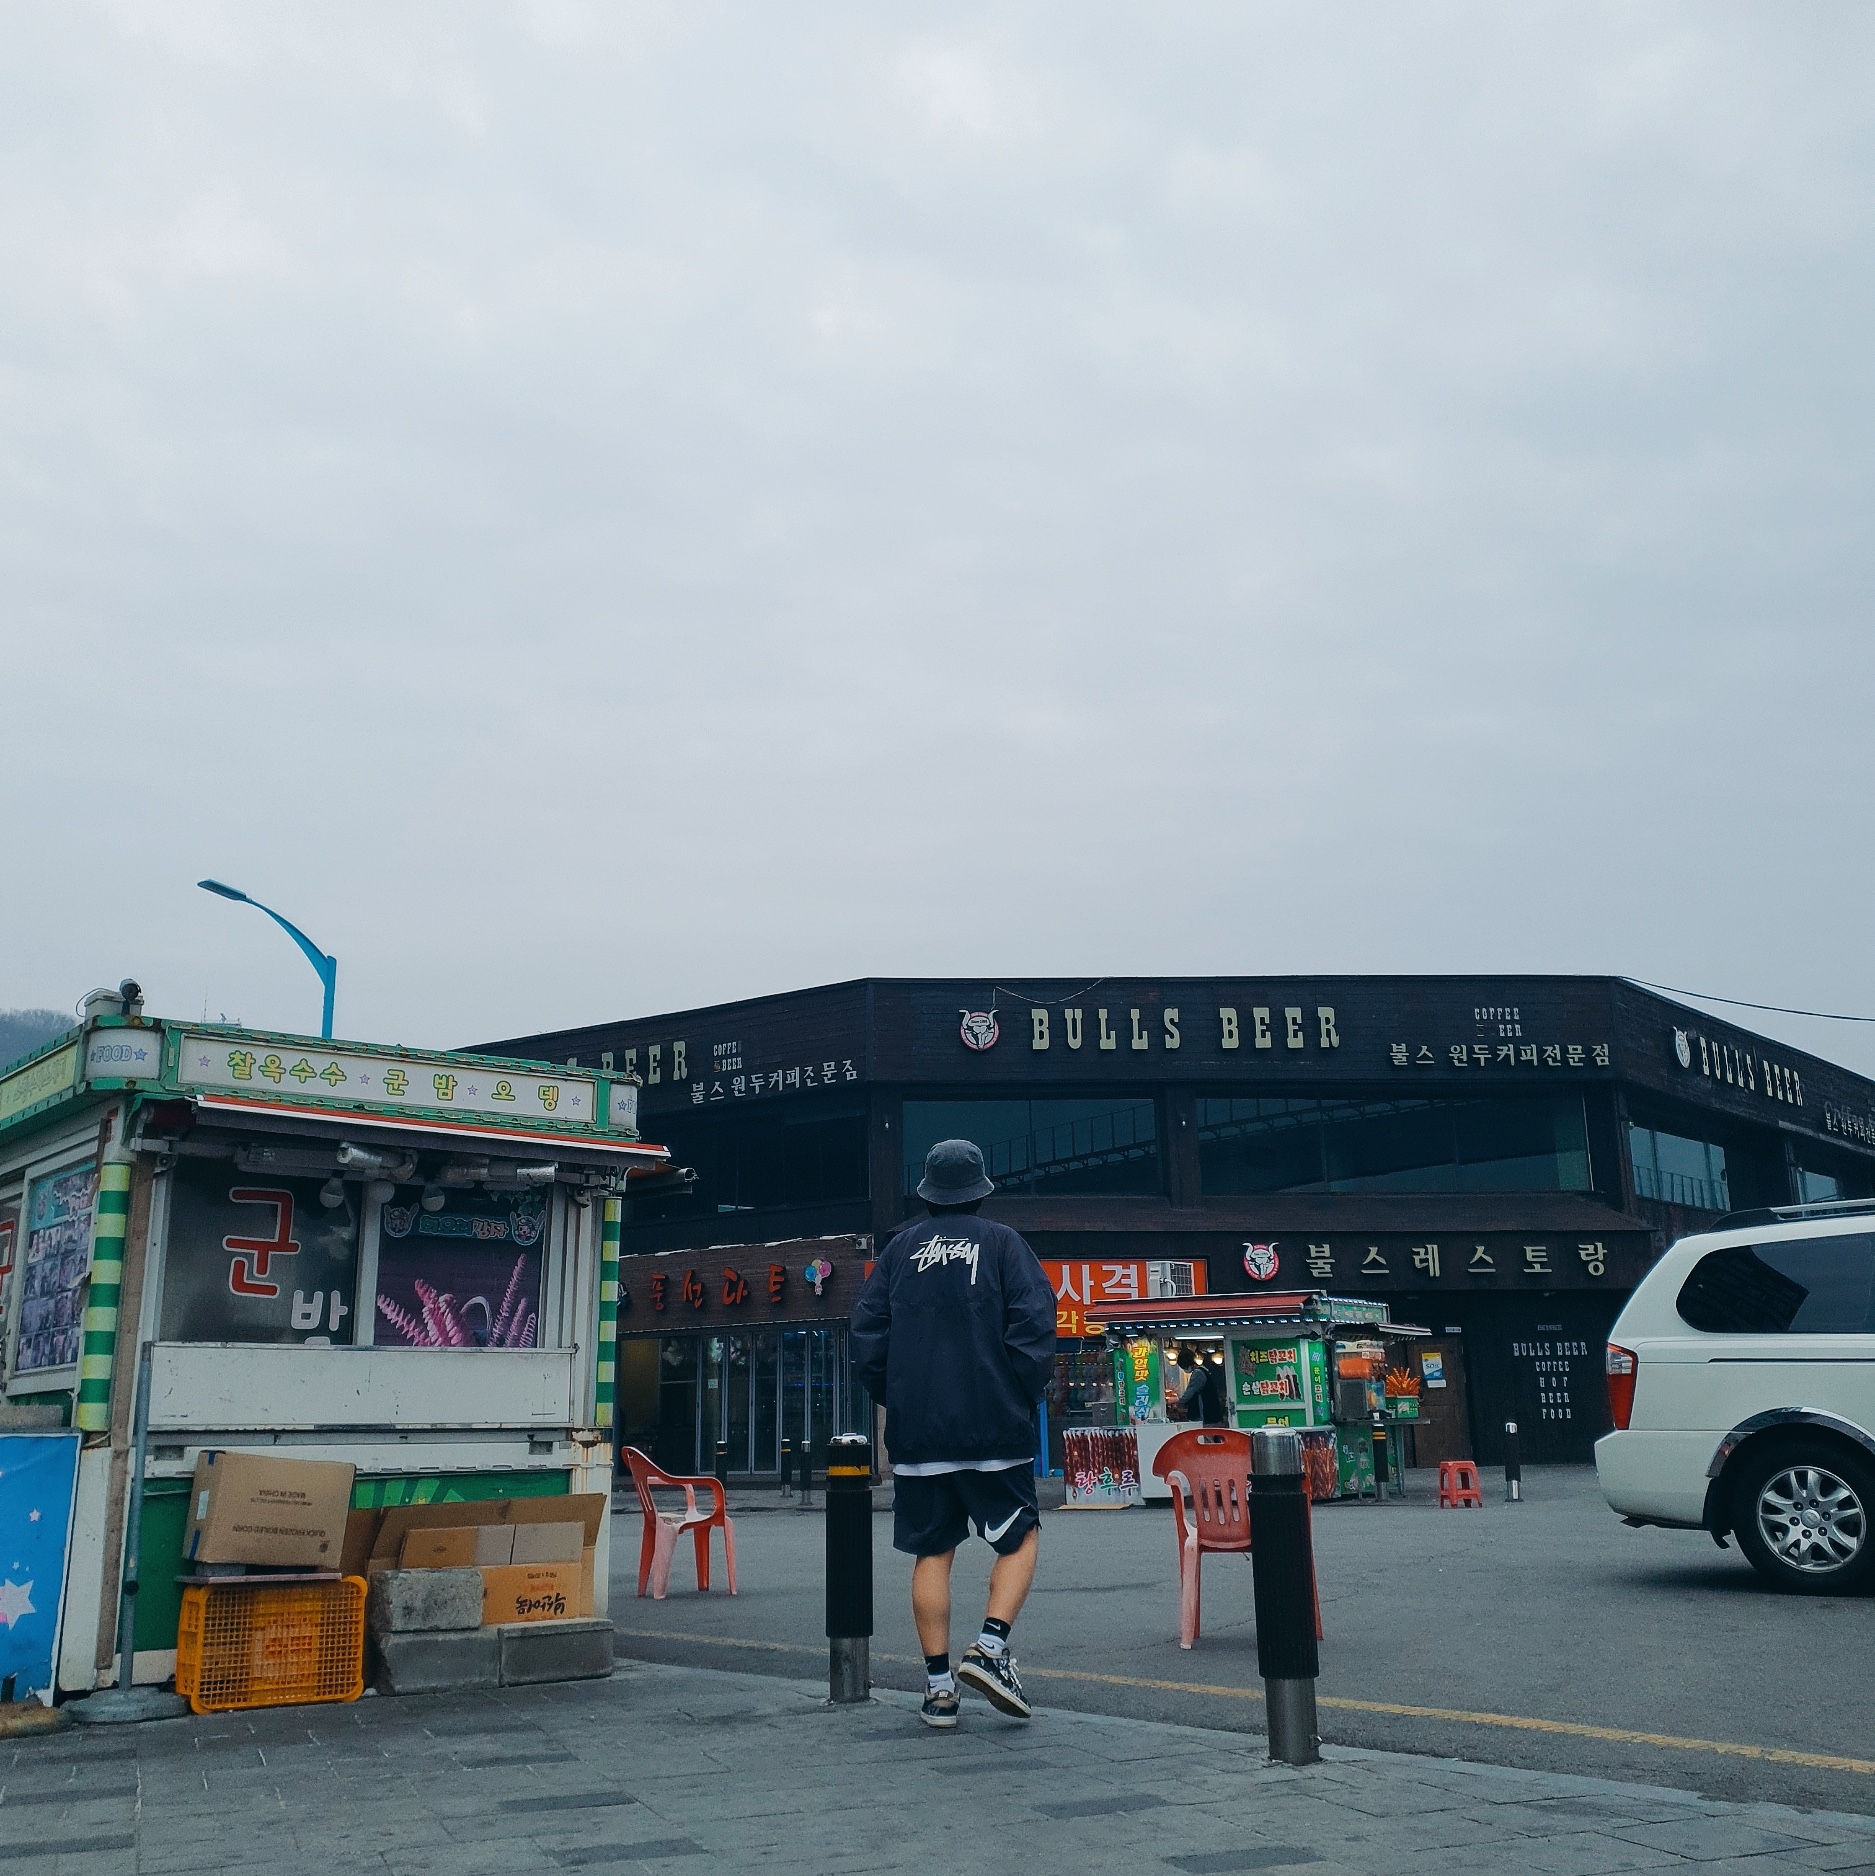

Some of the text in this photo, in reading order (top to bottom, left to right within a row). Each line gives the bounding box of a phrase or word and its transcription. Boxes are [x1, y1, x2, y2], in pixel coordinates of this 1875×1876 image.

[1474, 1007, 1520, 1020] COFFEE
[1031, 1006, 1340, 1050] BULLS BEER
[95, 1044, 133, 1062] FOOD
[1389, 1043, 1610, 1067] 불스 원두커피전문점
[227, 1049, 347, 1087] 찰옥수수
[721, 1057, 743, 1072] BEER
[1700, 1036, 1803, 1107] BULLS BEER
[690, 1081, 725, 1104] 불스
[1056, 1264, 1139, 1305] 사격
[1512, 1341, 1588, 1357] BULLS BEER
[1535, 1361, 1570, 1372] COFFEE
[1539, 1376, 1568, 1388] HOF
[1540, 1392, 1570, 1404] BEER
[1542, 1408, 1572, 1420] FOOD
[1075, 1466, 1140, 1495] 탕후루
[259, 1488, 280, 1499] CHINA
[288, 1490, 306, 1500] MADE
[515, 1592, 567, 1616] 부산어묵
